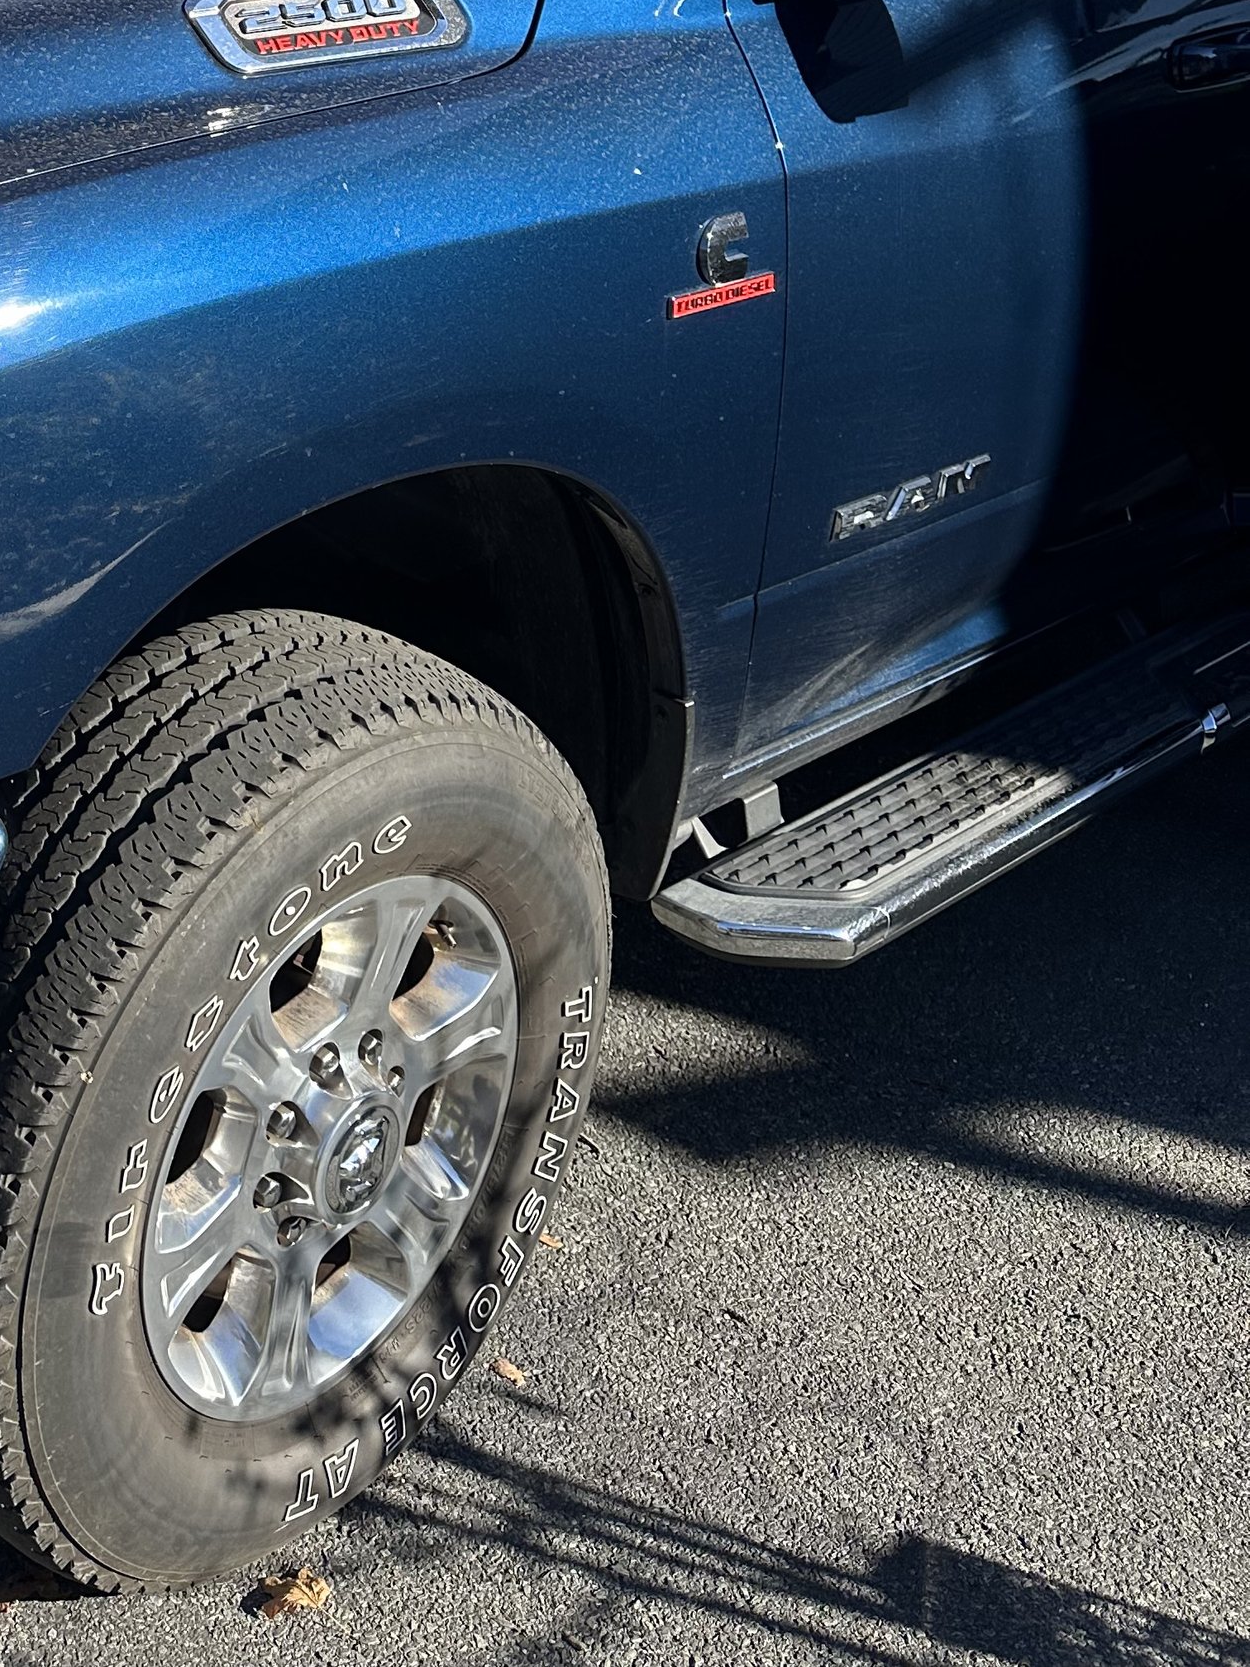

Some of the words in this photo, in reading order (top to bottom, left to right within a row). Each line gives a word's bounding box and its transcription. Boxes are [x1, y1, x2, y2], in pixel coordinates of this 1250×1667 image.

[256, 29, 348, 55] HEAVY
[350, 18, 421, 42] DUTY
[676, 291, 723, 313] TURBO
[725, 278, 773, 301] DIESEL
[379, 985, 593, 1457] TRANSFORCE
[283, 1438, 360, 1523] AT
